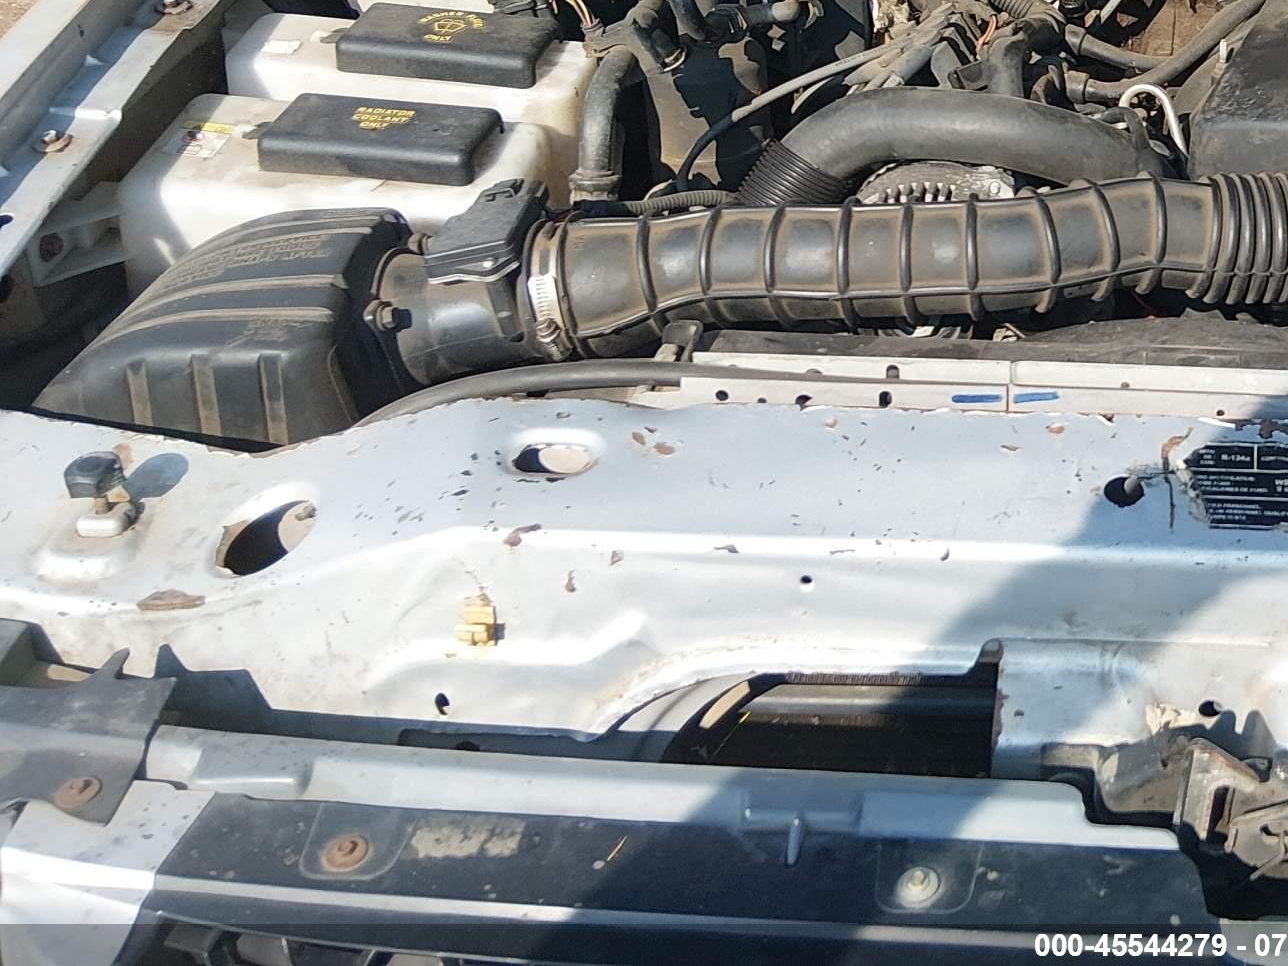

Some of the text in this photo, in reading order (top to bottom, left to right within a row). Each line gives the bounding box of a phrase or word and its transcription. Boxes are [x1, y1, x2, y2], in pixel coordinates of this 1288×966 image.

[355, 106, 417, 117] RADIATOR
[352, 113, 410, 123] COOLANT
[359, 121, 391, 130] ONLY
